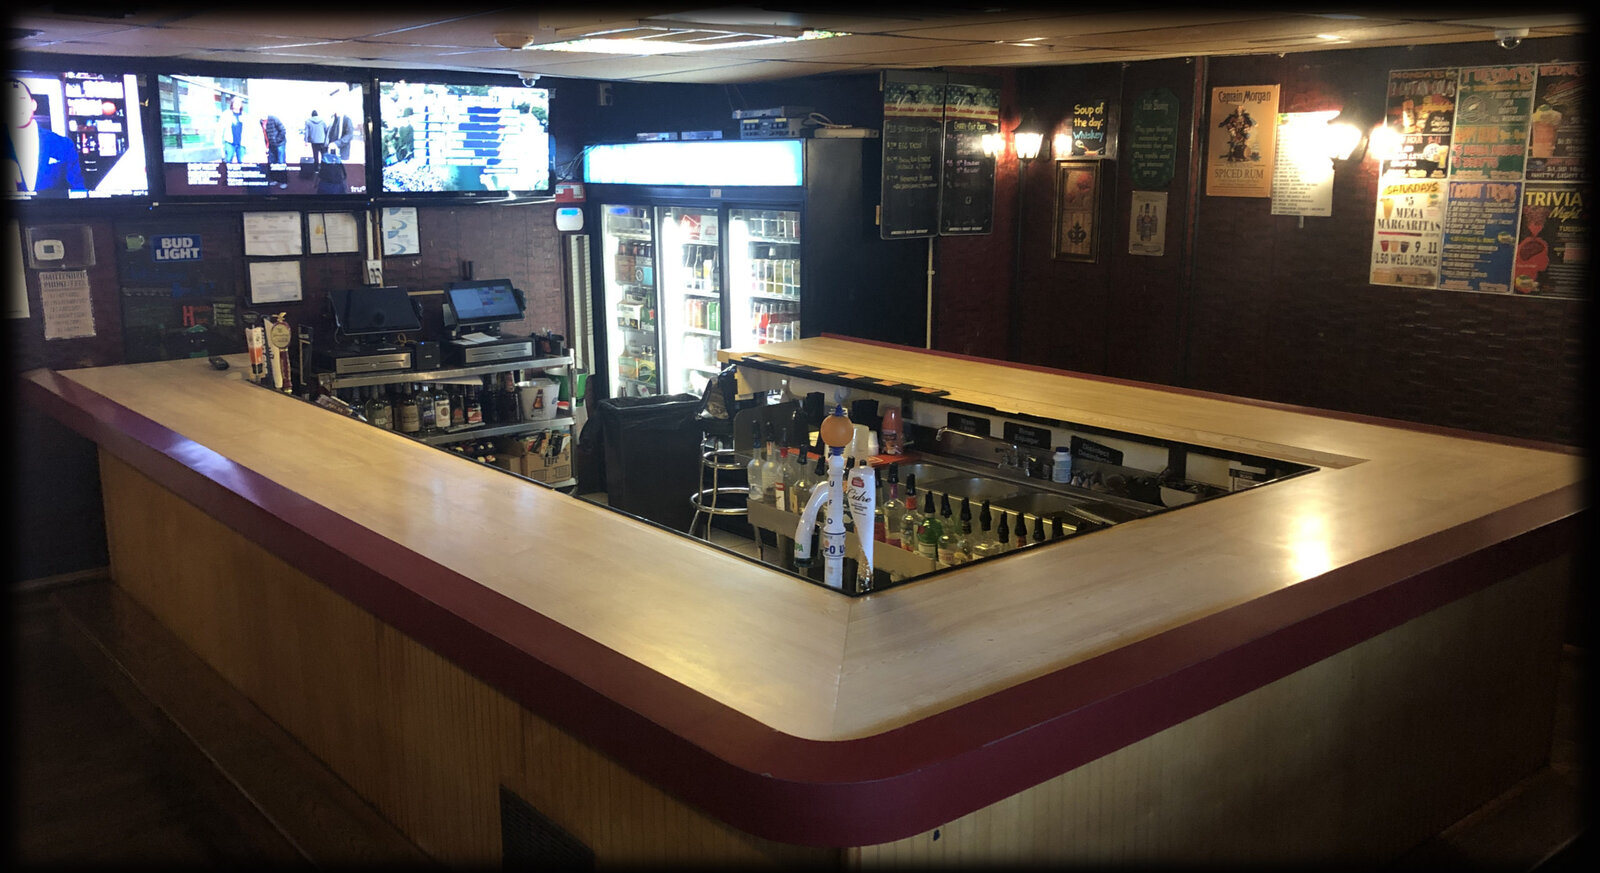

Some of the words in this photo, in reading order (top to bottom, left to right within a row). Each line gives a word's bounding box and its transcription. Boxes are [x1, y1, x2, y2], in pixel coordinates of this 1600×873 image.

[1218, 89, 1242, 103] Captain
[1242, 90, 1271, 104] Morgan
[1074, 104, 1093, 117] Soup
[1094, 102, 1105, 114] of
[1074, 118, 1087, 127] the
[1073, 131, 1104, 142] Whiskey
[1215, 168, 1242, 178] SPICED
[1244, 168, 1264, 179] RUM
[1388, 182, 1438, 194] SATURDAYS
[1526, 191, 1583, 206] TRIVIA
[1396, 207, 1423, 219] MEGA
[1549, 207, 1583, 223] Night
[1378, 219, 1440, 231] MARGARITAS
[161, 237, 193, 249] BUD
[1415, 241, 1421, 253] 9
[156, 248, 200, 260] LIGHT
[1390, 254, 1408, 265] WELL
[1410, 254, 1437, 267] DRINKS
[847, 488, 872, 503] Cidre
